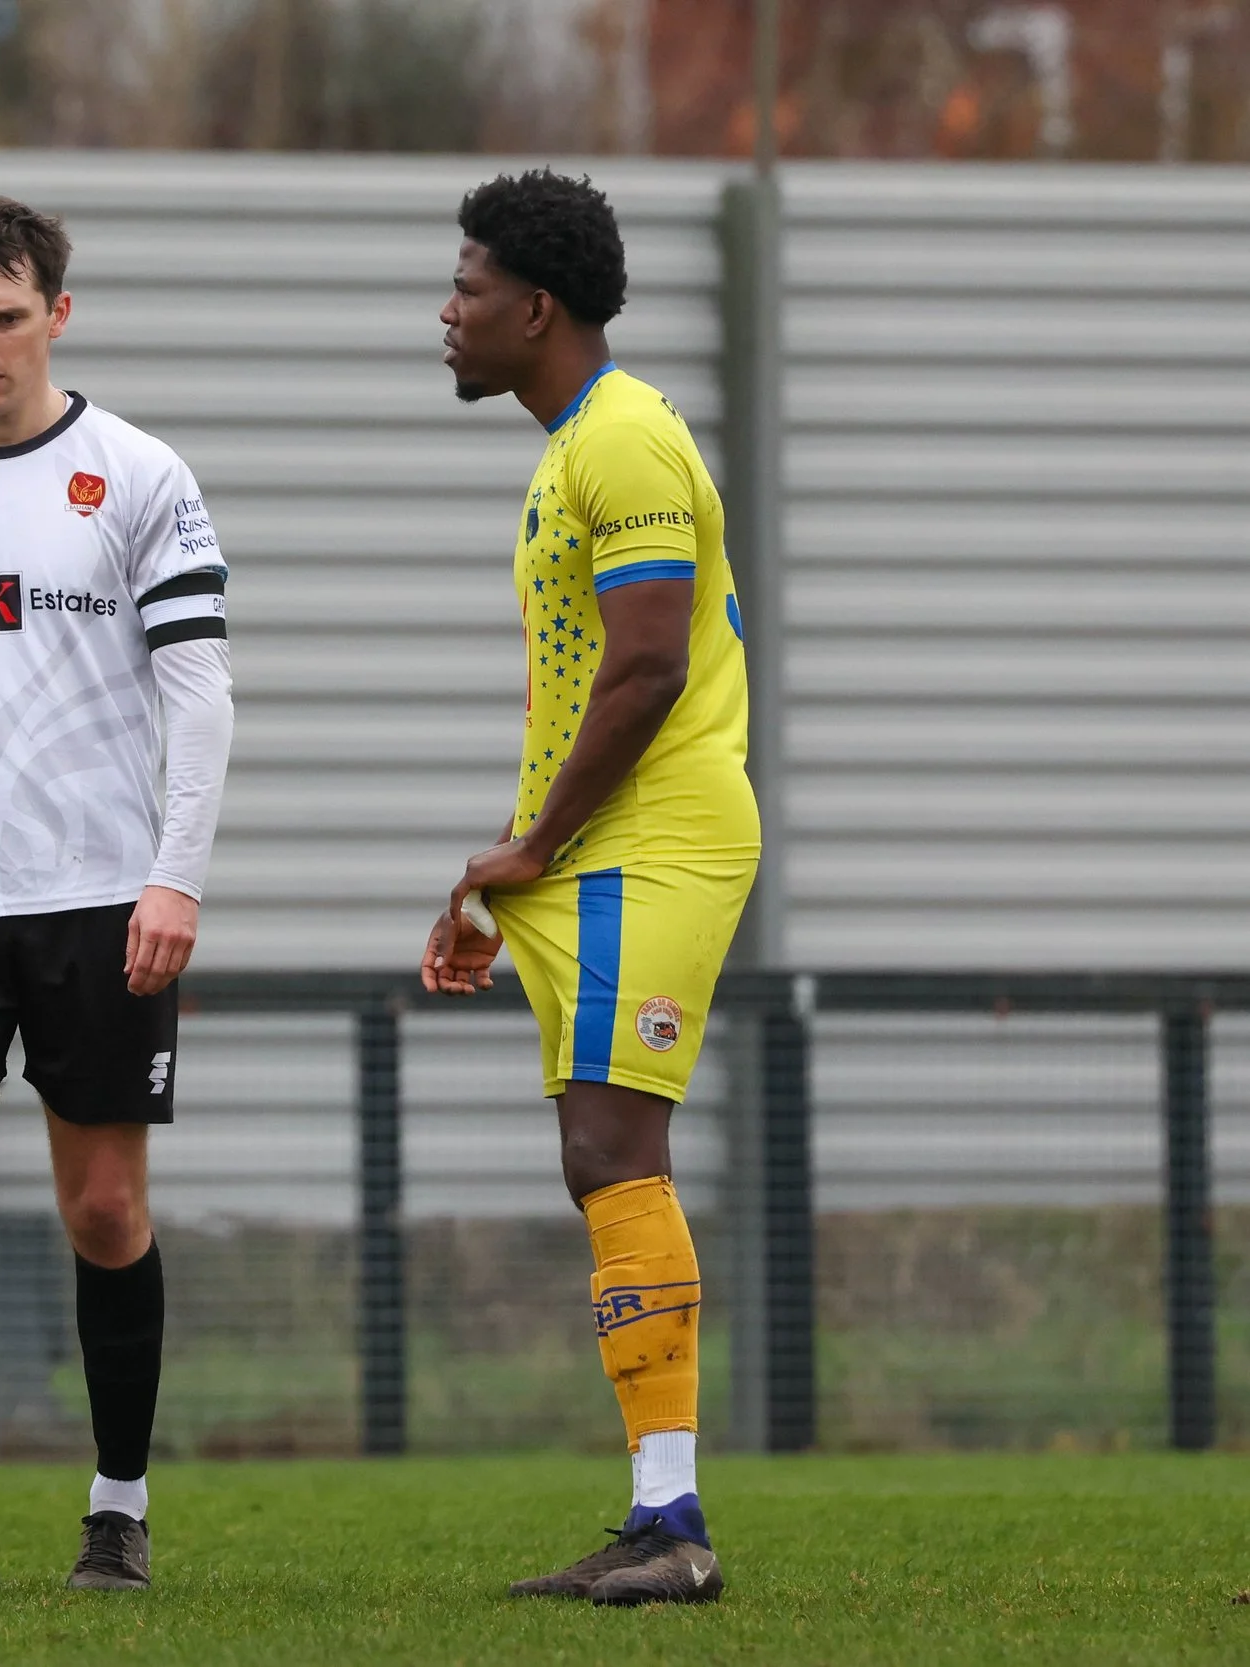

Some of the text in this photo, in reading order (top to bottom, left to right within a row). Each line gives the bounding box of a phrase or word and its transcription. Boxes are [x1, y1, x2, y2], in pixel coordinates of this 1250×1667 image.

[177, 517, 211, 536] Russ
[625, 512, 680, 530] CLIFFIE
[30, 588, 118, 617] Estates
